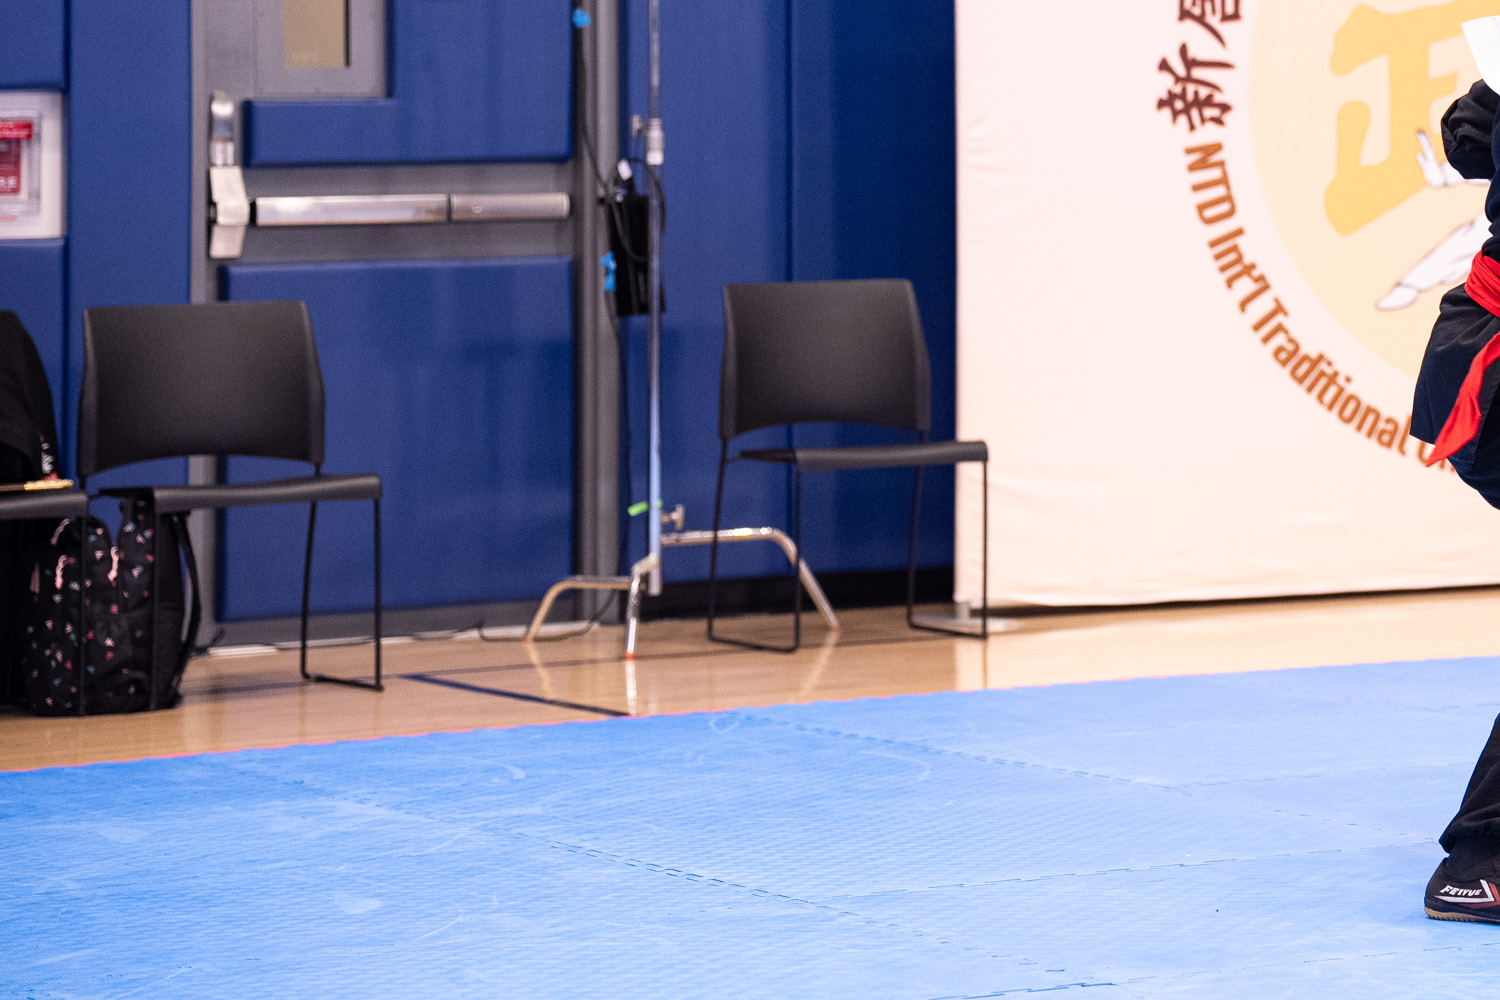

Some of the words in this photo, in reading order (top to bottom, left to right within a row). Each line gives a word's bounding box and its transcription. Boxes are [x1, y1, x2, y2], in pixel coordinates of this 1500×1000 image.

[1184, 142, 1236, 225] NTD
[1207, 226, 1271, 314] Int'l
[1251, 297, 1411, 456] Traditional
